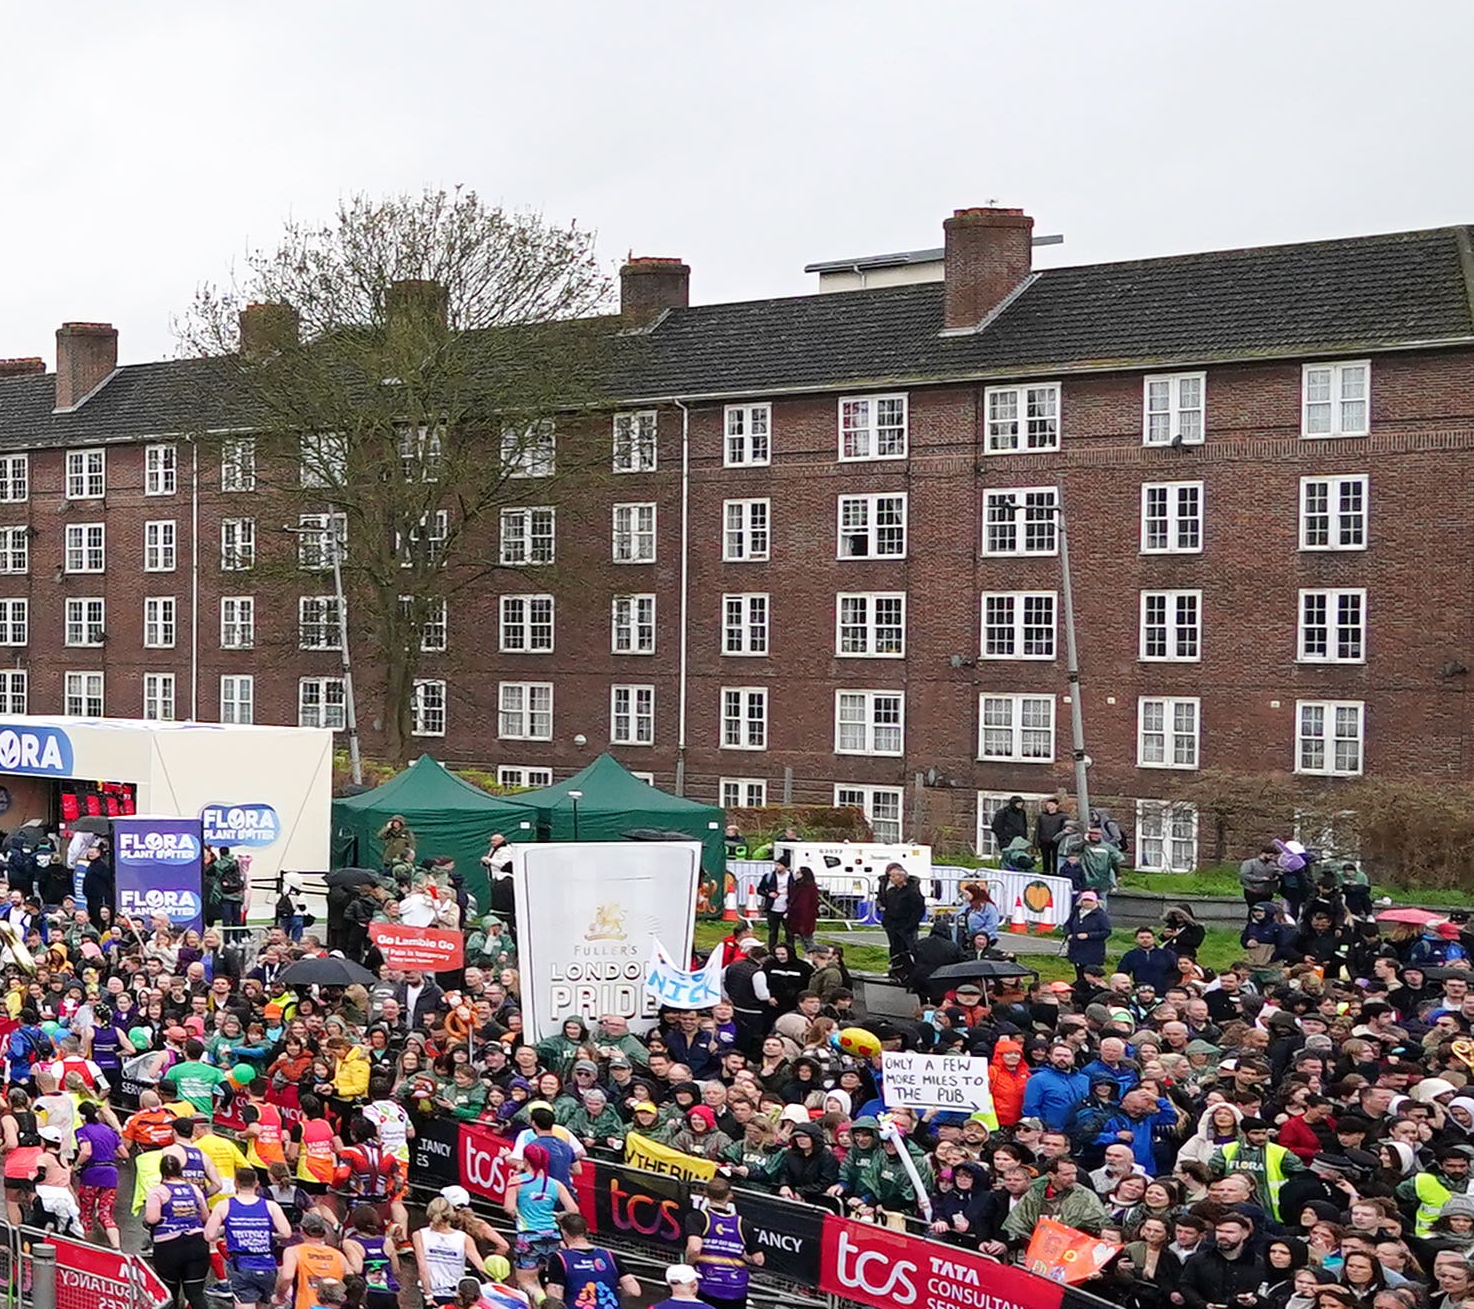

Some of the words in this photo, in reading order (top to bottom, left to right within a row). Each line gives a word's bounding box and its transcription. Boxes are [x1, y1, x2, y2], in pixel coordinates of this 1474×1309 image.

[203, 805, 275, 829] FLORA
[120, 833, 195, 851] FLORA
[120, 890, 195, 908] FLORA
[573, 943, 638, 956] FULLER'S
[550, 961, 648, 982] LONDO
[647, 970, 723, 1004] NICK
[885, 1056, 913, 1073] ONLY
[925, 1057, 935, 1071] A
[944, 1057, 971, 1072] FEW
[886, 1072, 918, 1086] MORE
[922, 1074, 958, 1087] MILES
[962, 1076, 985, 1088] TO
[893, 1086, 922, 1102] THE
[937, 1087, 965, 1104] PUB
[609, 1178, 682, 1241] tcs
[837, 1231, 918, 1307] tcs
[930, 1257, 979, 1286] TATA
